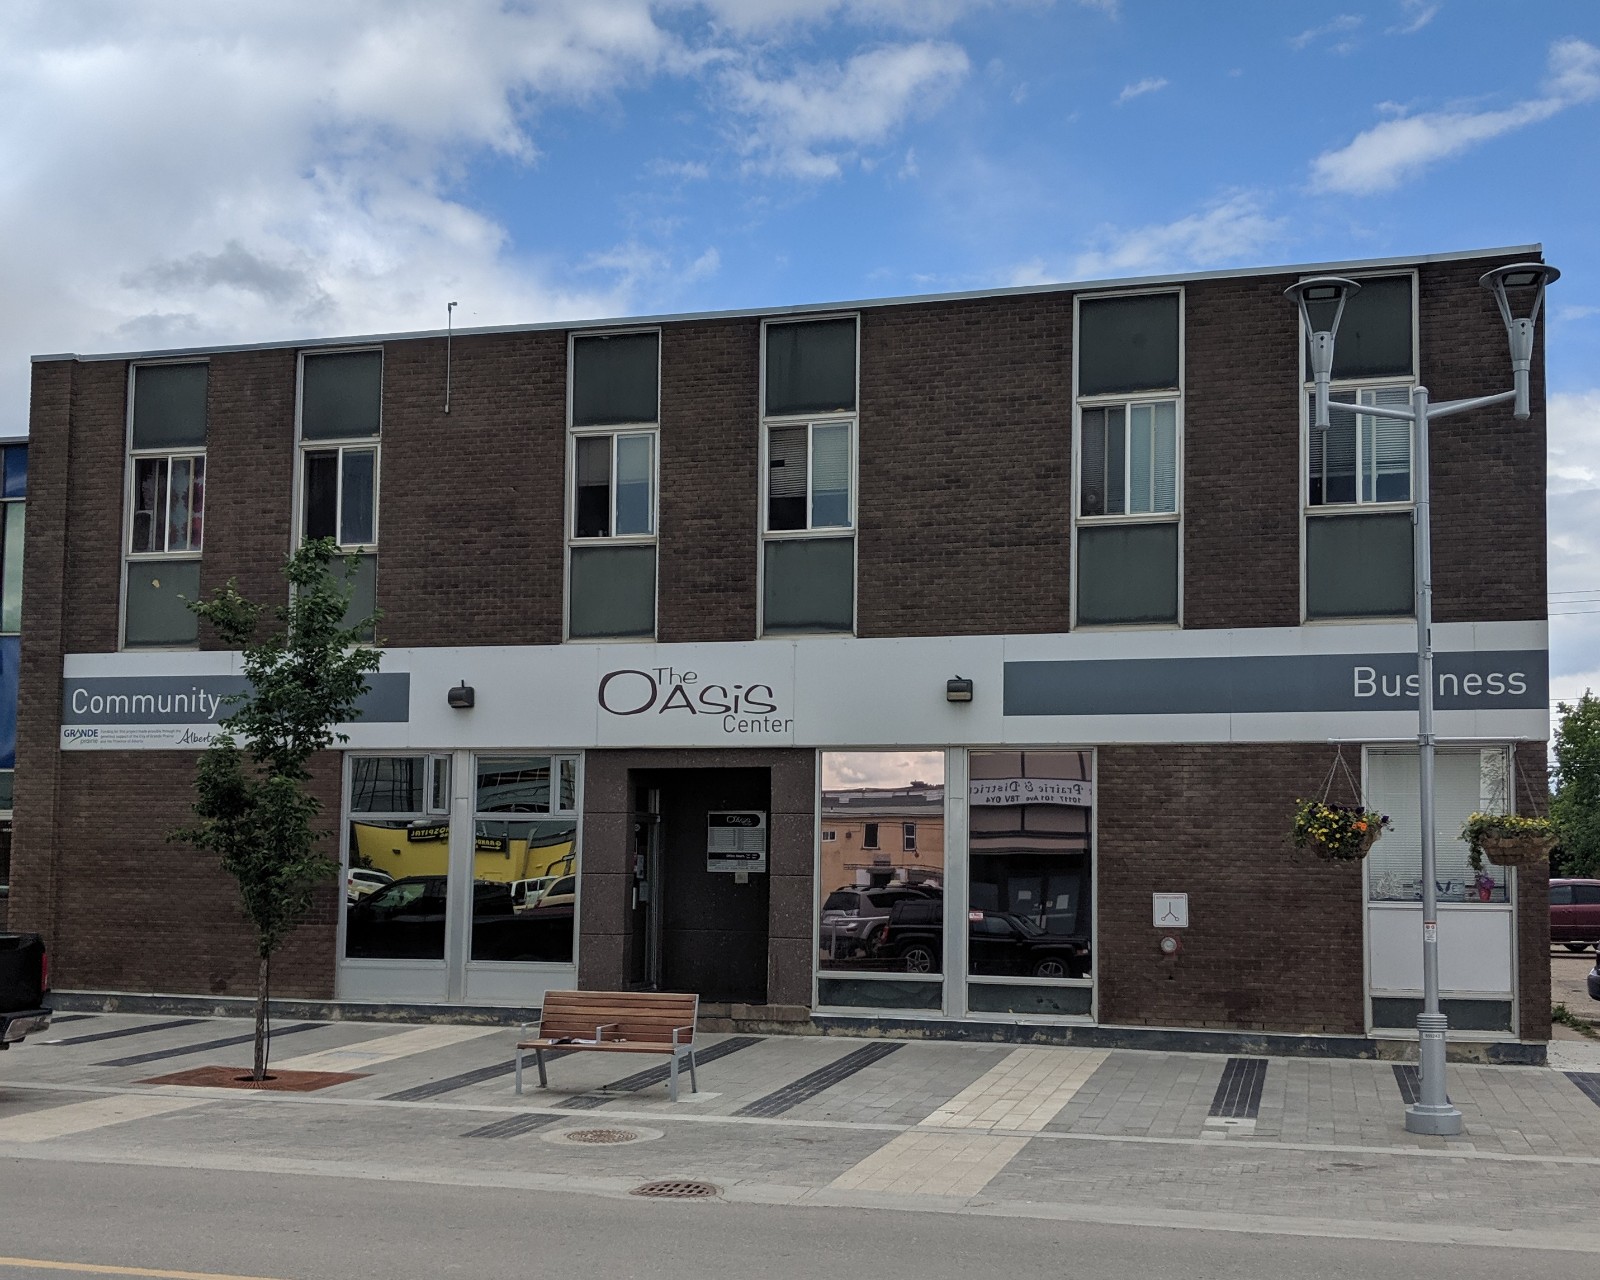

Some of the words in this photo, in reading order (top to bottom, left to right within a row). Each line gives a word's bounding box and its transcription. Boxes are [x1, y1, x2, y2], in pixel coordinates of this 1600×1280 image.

[652, 667, 698, 685] The
[1354, 667, 1527, 697] Busness
[72, 687, 221, 719] Community
[63, 728, 99, 738] GRANDE
[723, 715, 794, 733] Center
